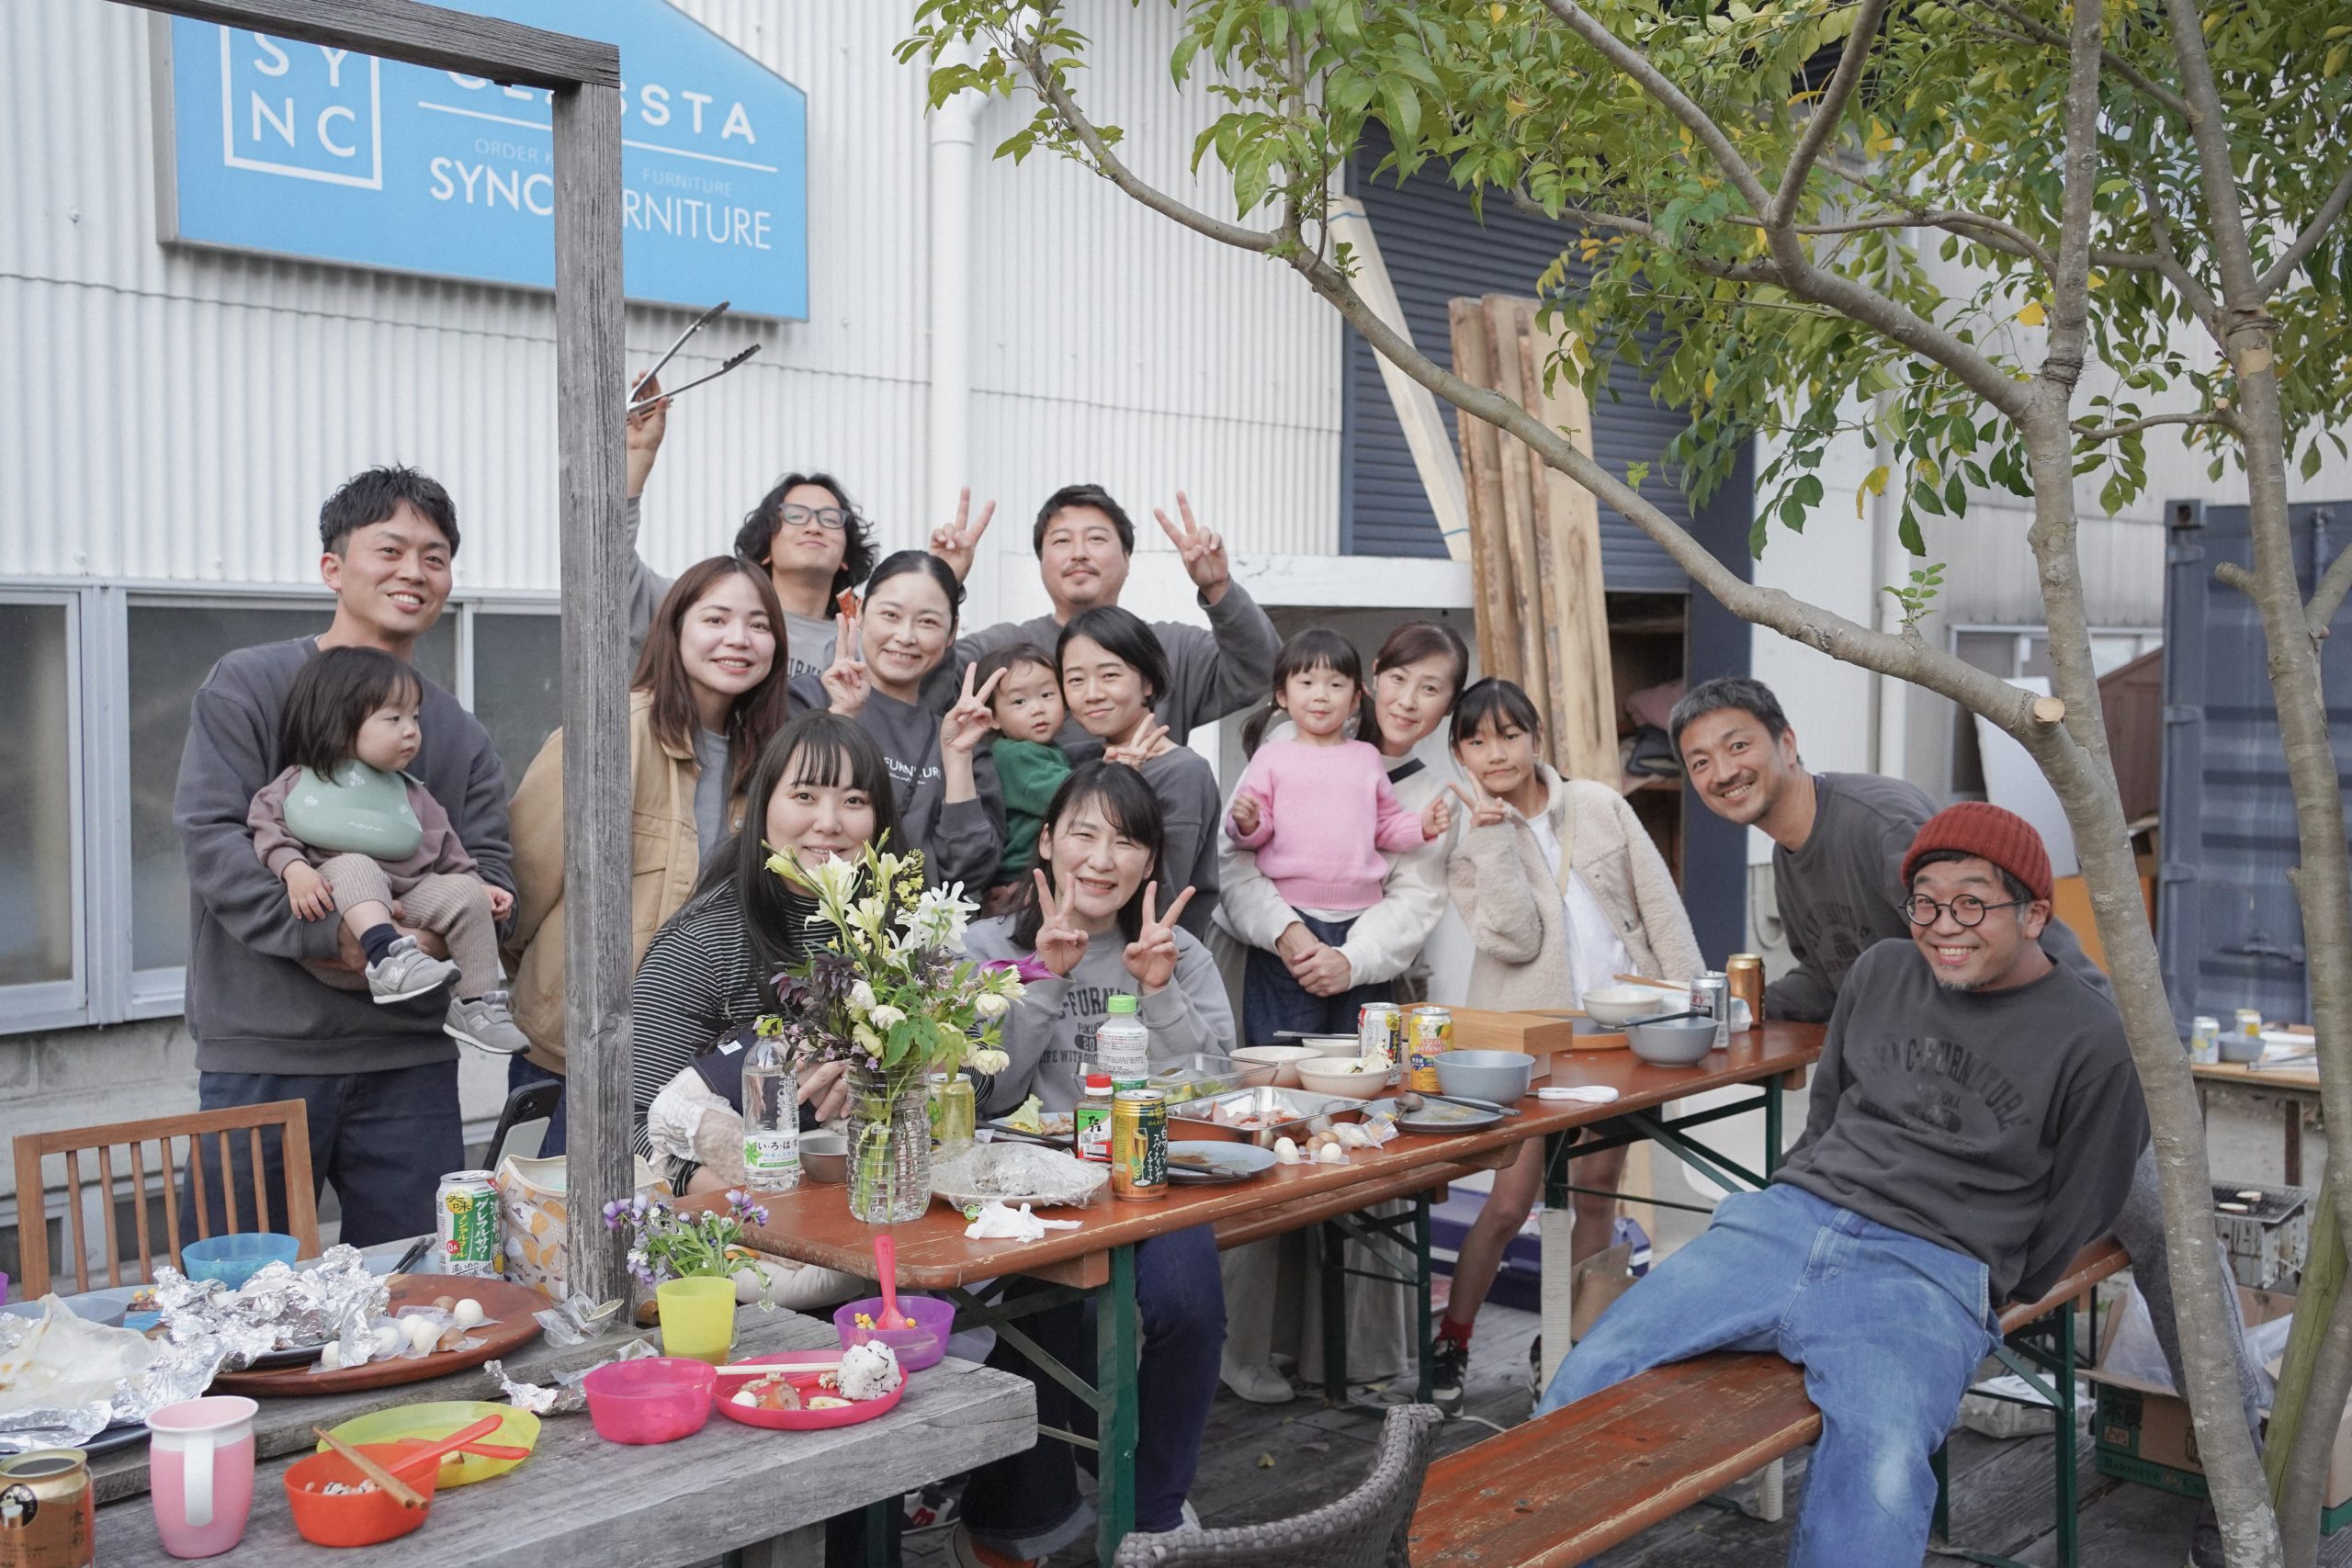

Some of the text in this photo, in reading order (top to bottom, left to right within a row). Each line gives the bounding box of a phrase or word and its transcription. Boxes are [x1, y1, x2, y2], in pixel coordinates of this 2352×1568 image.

[475, 138, 538, 164] ORDER
[643, 167, 733, 198] FURNITURE
[430, 156, 771, 250] SYNC RNITURE
[1078, 1021, 1104, 1033] FUKUO
[1082, 1037, 1096, 1050] 20
[456, 1214, 469, 1258] ノンアルコール
[475, 1197, 490, 1259] グレフルサワー
